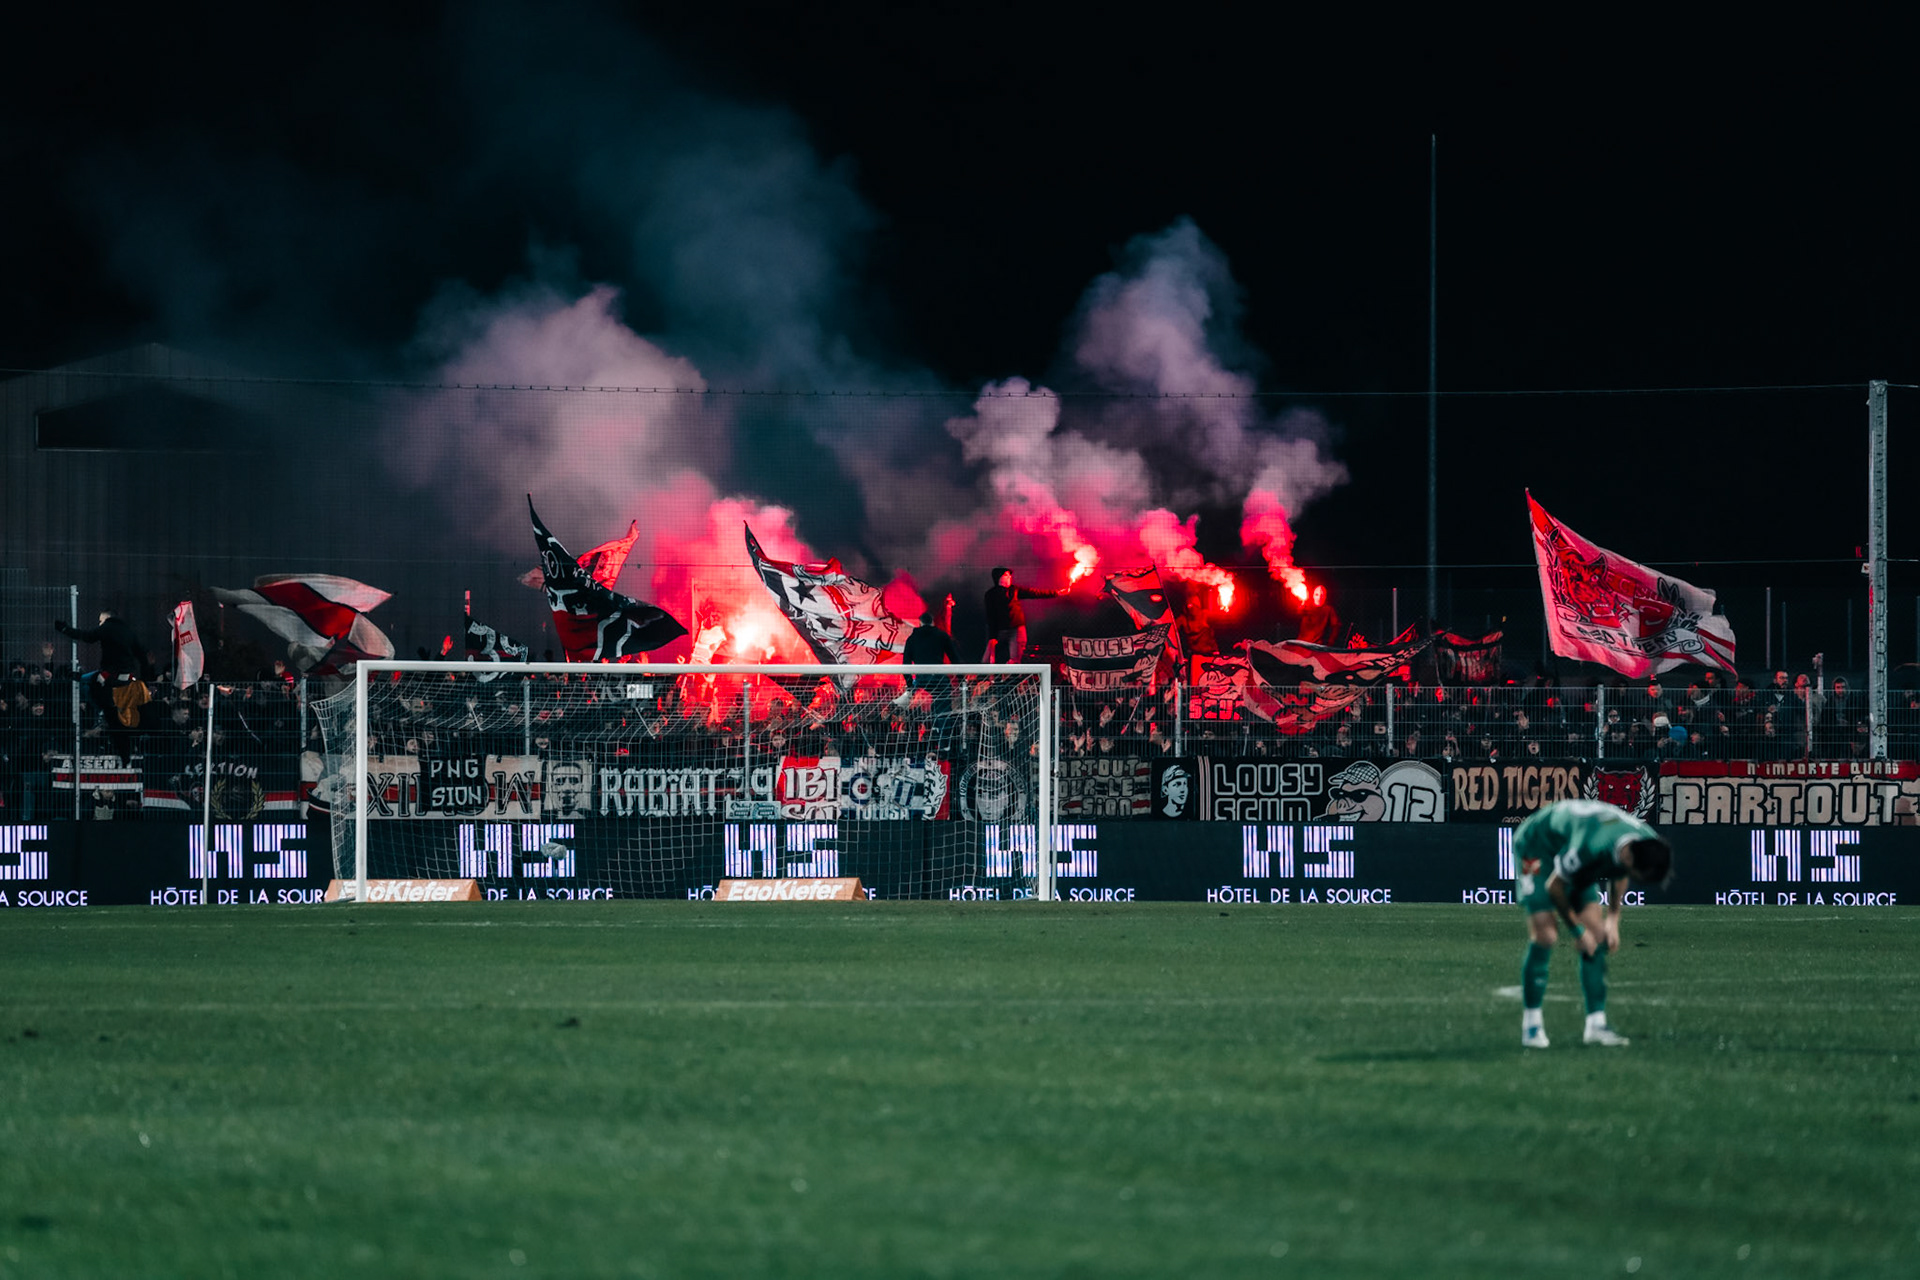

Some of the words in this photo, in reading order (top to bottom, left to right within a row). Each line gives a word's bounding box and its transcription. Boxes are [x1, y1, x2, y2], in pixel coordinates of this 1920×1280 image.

[1067, 637, 1134, 657] LOUSY
[431, 759, 478, 778] PNG
[1059, 759, 1138, 778] ARTOUT
[1059, 778, 1096, 798] OUR
[1108, 778, 1133, 797] LE
[1214, 763, 1323, 796] LOUSY
[1453, 766, 1500, 812] RED
[1503, 766, 1580, 811] TIGERS
[432, 786, 482, 806] SION
[1388, 783, 1438, 822] 12
[1674, 783, 1899, 825] PARTOUT
[18, 890, 88, 907] SOURCE
[218, 889, 239, 905] DE
[250, 889, 270, 904] LA
[277, 888, 328, 905] SOUR
[519, 888, 536, 901] LA
[546, 888, 614, 901] SOURCE
[1069, 887, 1135, 902] SOURCE
[1270, 888, 1290, 904] DE
[1300, 888, 1319, 904] LA
[1326, 888, 1391, 904] SOURCE
[1778, 891, 1797, 906] DE
[1807, 891, 1825, 906] LA
[1833, 891, 1897, 906] SOURCE
